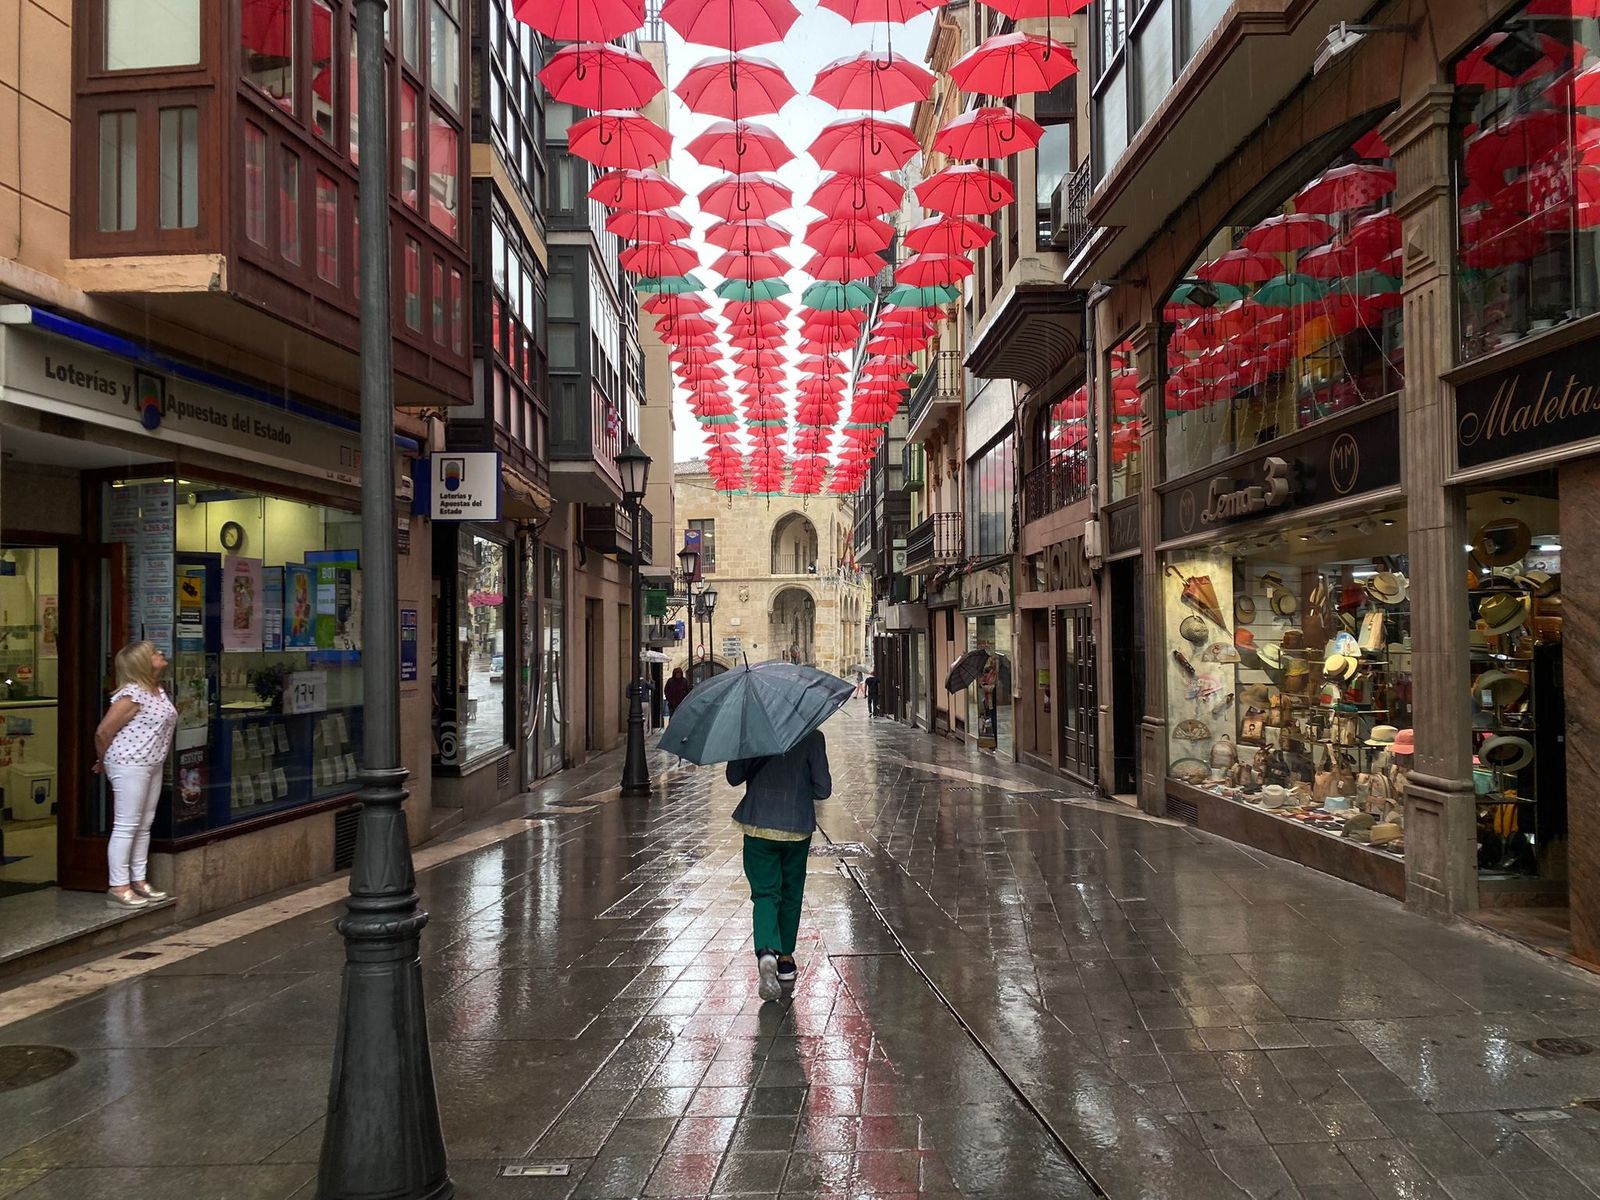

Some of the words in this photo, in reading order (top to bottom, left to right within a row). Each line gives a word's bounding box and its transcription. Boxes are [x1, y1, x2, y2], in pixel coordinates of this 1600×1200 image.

[44, 356, 118, 396] Loterías
[121, 383, 131, 405] y
[166, 393, 228, 428] Apuestas
[231, 412, 250, 434] del
[253, 419, 292, 445] Estado
[440, 500, 471, 508] Apuestas
[1200, 476, 1264, 525] Lema
[1263, 456, 1288, 506] 3
